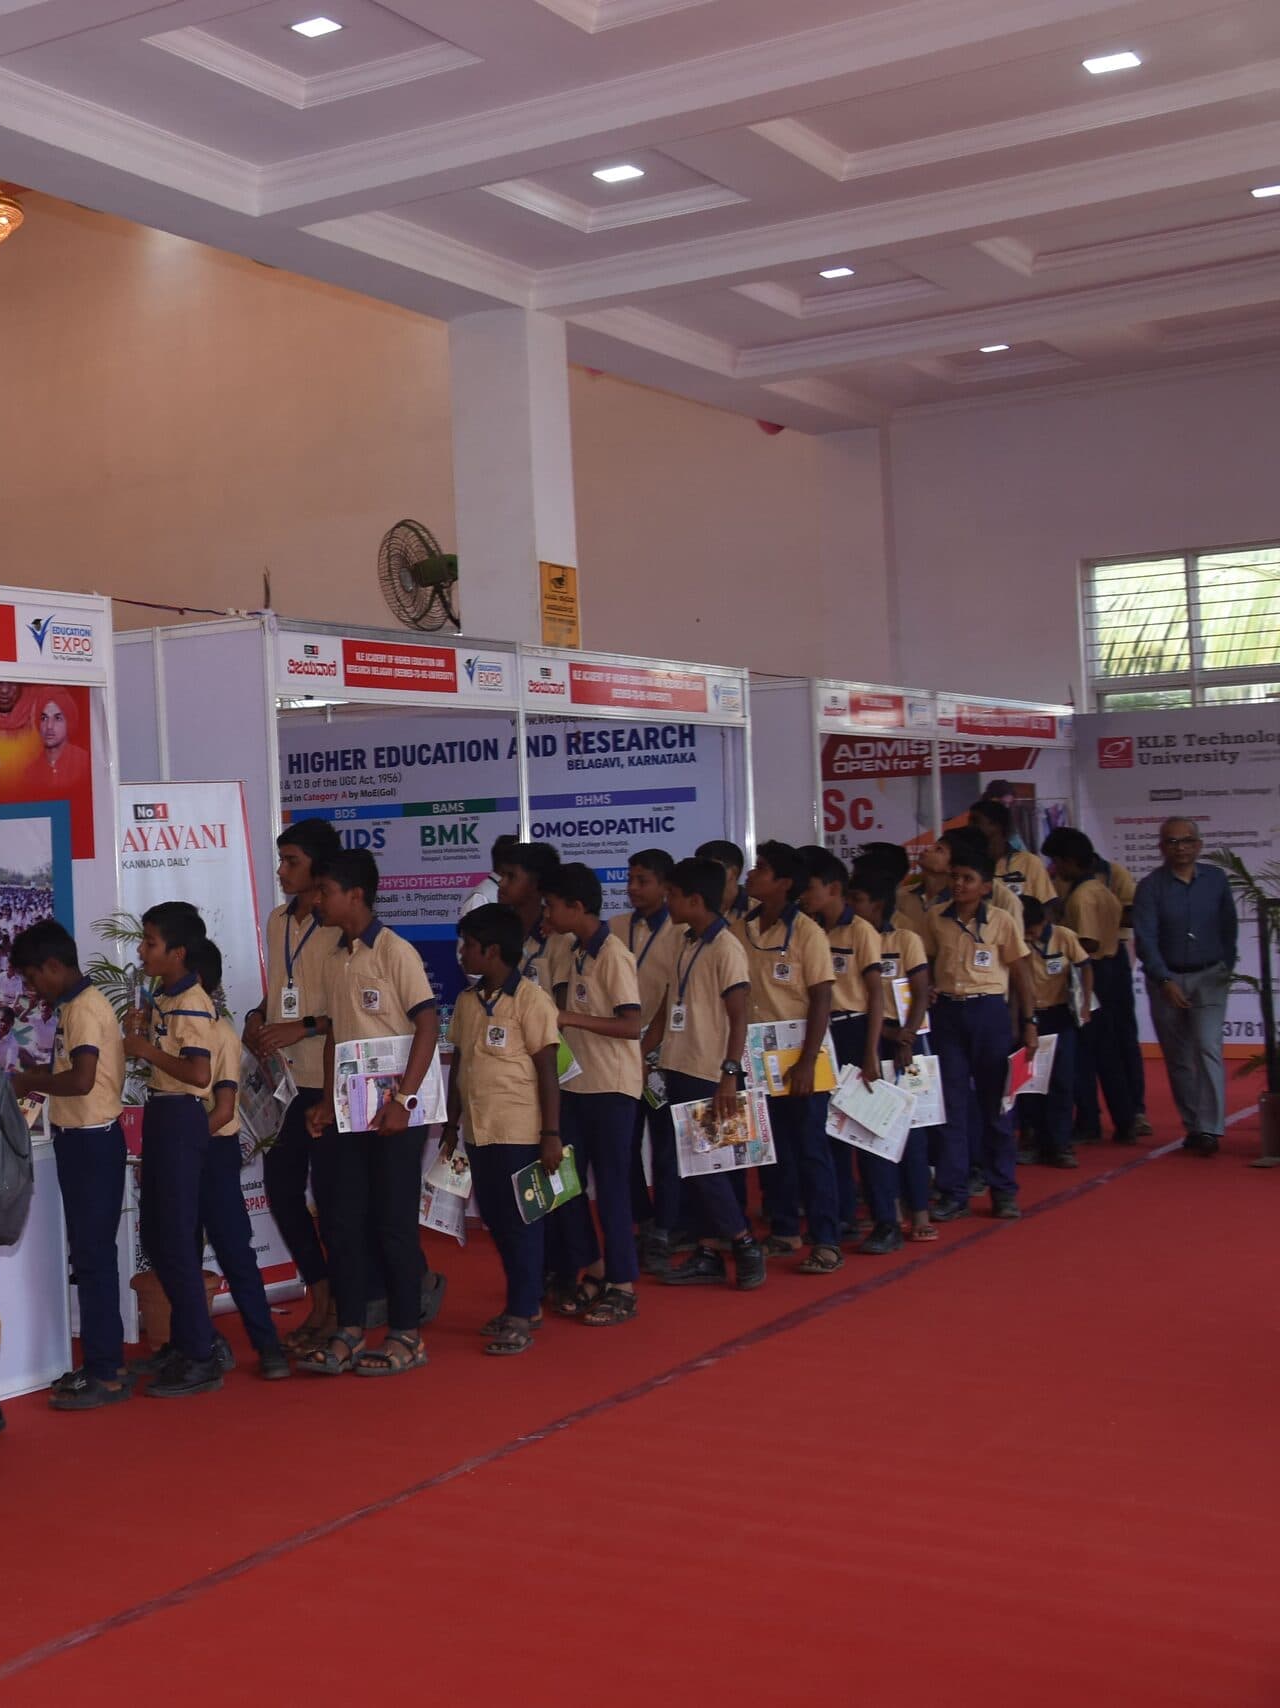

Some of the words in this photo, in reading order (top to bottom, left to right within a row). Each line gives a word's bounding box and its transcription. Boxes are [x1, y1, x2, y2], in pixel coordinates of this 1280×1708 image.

[52, 626, 91, 637] EDUCATION
[53, 636, 91, 653] EXPO
[1136, 735, 1177, 749] KLE
[1183, 729, 1280, 748] Technolo
[287, 747, 368, 775] HIGHER
[373, 737, 499, 769] EDUCATION
[506, 733, 557, 760] AND
[566, 723, 697, 756] RESEARCH
[567, 756, 625, 771] BELAGAVI,
[627, 751, 697, 767] KARNATAKA
[1138, 749, 1240, 766] University
[833, 759, 891, 774] OPEN
[893, 758, 921, 771] for
[312, 778, 321, 788] of
[323, 778, 338, 788] the
[339, 776, 357, 787] UGC
[303, 791, 338, 803] Category
[575, 793, 612, 807] BHMS
[334, 808, 358, 820] BDS
[432, 801, 465, 815] BAMS
[121, 823, 229, 854] AYAVANI
[420, 822, 480, 848] BMK
[121, 857, 165, 870] KANNADA
[166, 856, 191, 867] DAILY
[378, 876, 471, 889] PHYSIOTHERAPY
[414, 893, 462, 904] Physiotherapy
[420, 908, 449, 918] Therapy
